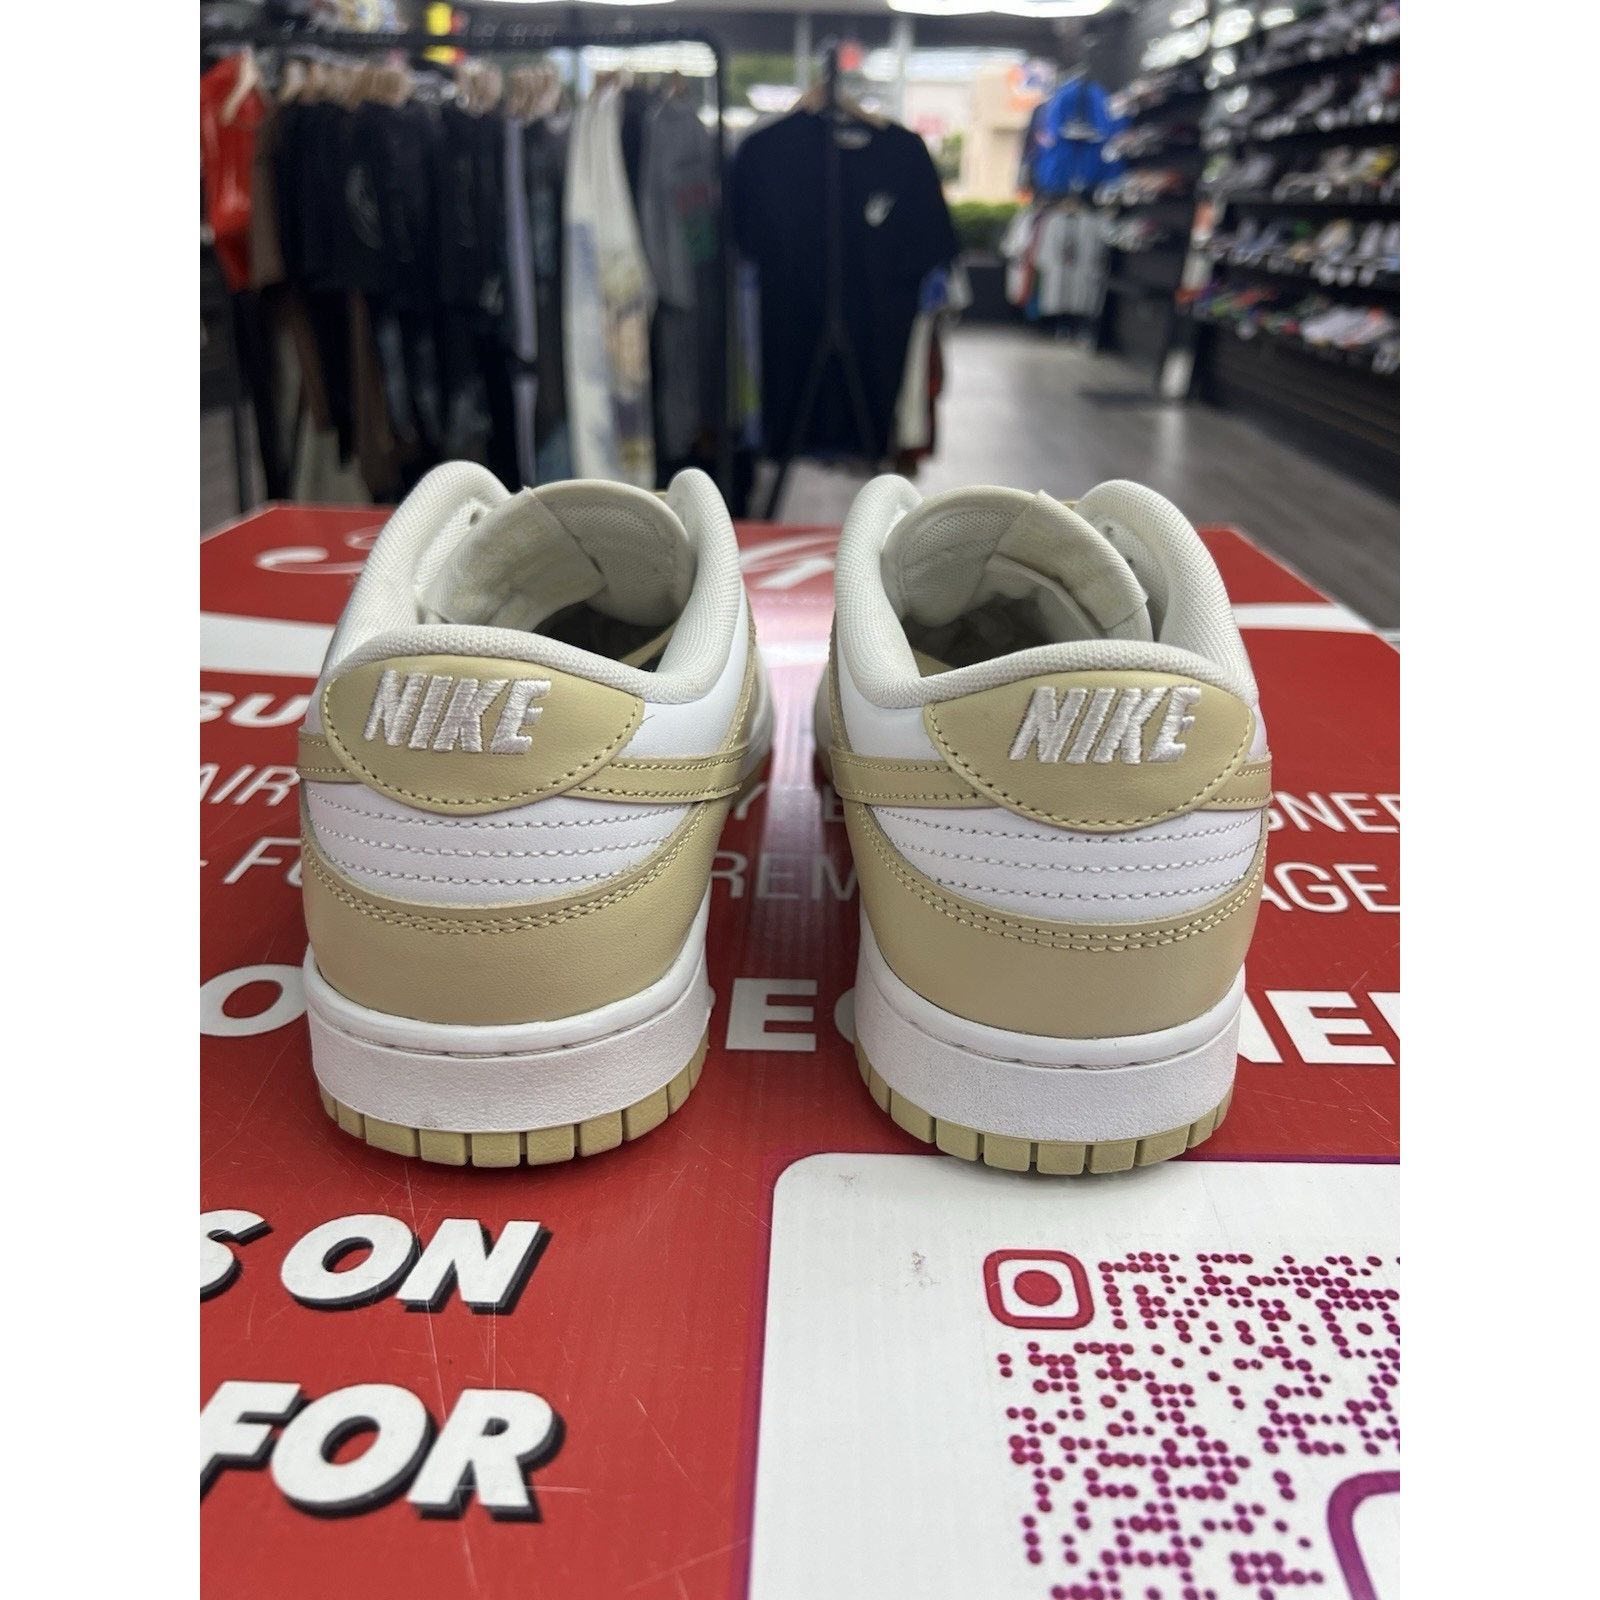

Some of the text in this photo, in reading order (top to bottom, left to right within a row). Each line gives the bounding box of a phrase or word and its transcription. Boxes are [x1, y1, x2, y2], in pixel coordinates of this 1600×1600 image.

[364, 669, 552, 755] NIKE
[1009, 686, 1202, 764] NIKE
[280, 1213, 553, 1314] ON
[200, 1379, 567, 1523] FOR
